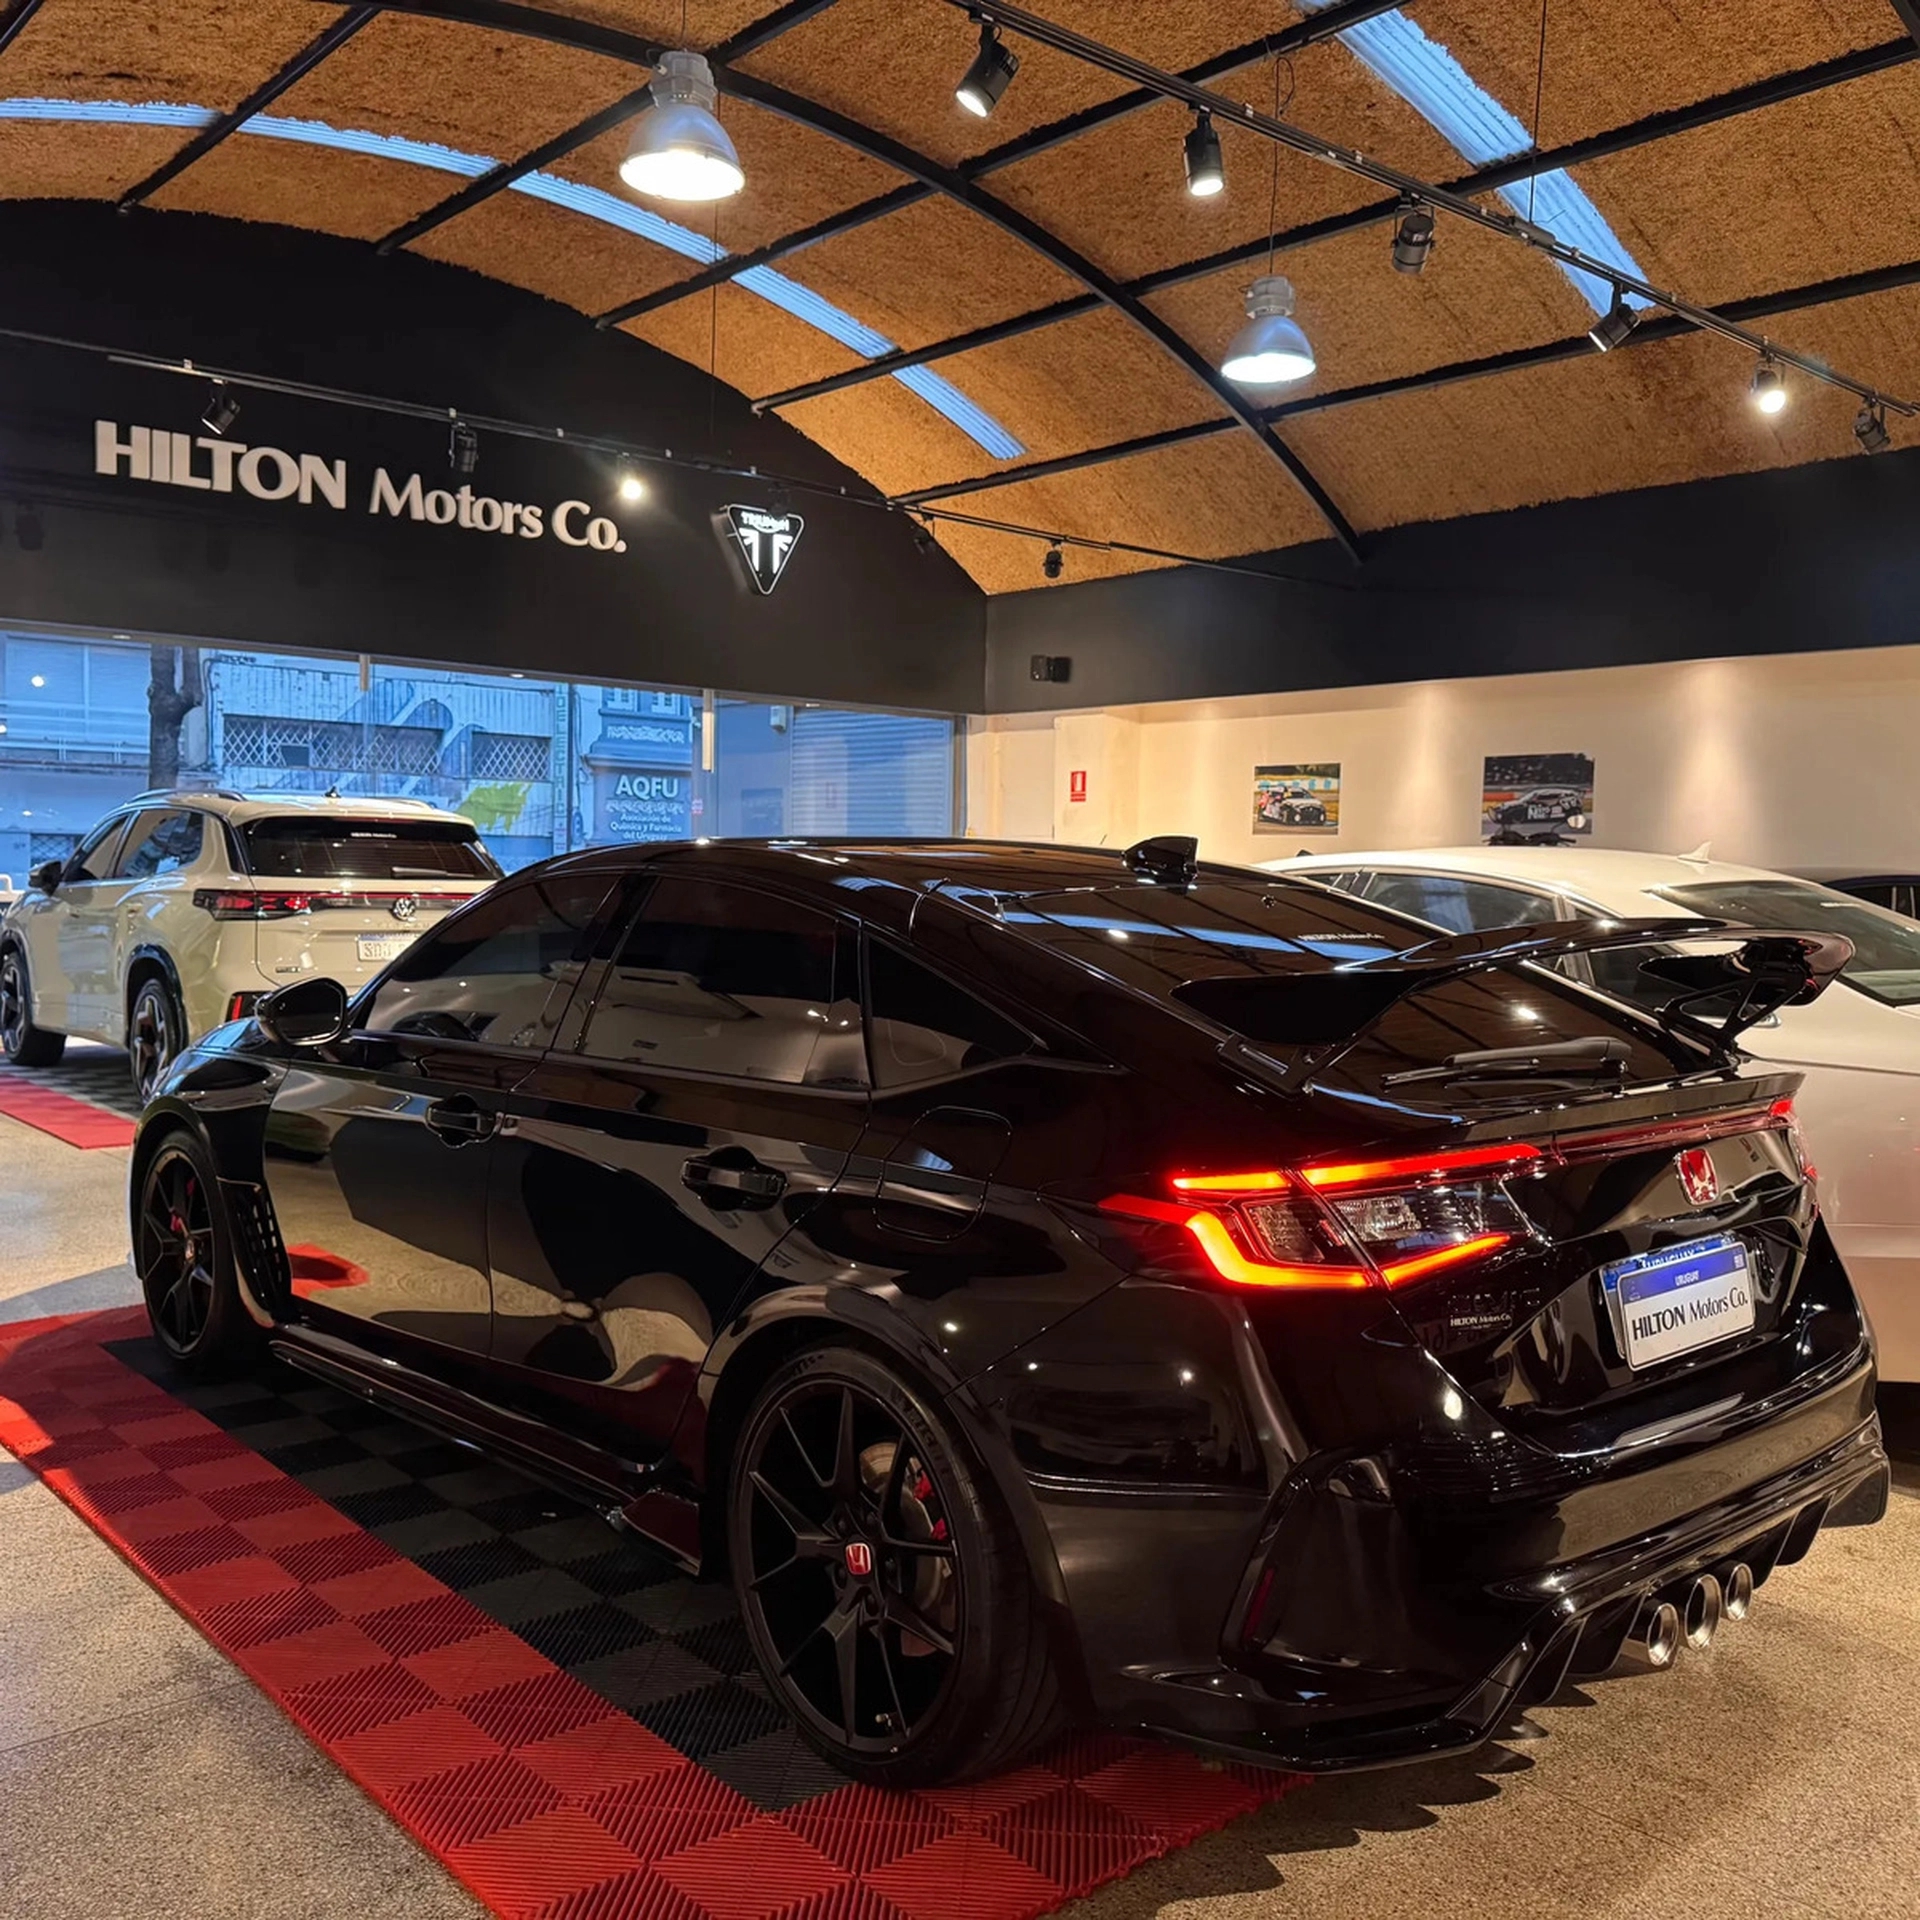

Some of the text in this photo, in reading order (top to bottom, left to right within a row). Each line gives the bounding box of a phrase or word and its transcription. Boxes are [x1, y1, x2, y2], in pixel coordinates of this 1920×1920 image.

[95, 419, 628, 553] HILTON Motors Co.
[616, 775, 678, 799] AQFU
[1449, 1316, 1478, 1327] HILTON
[1631, 1287, 1749, 1341] HILTON Motors Co.
